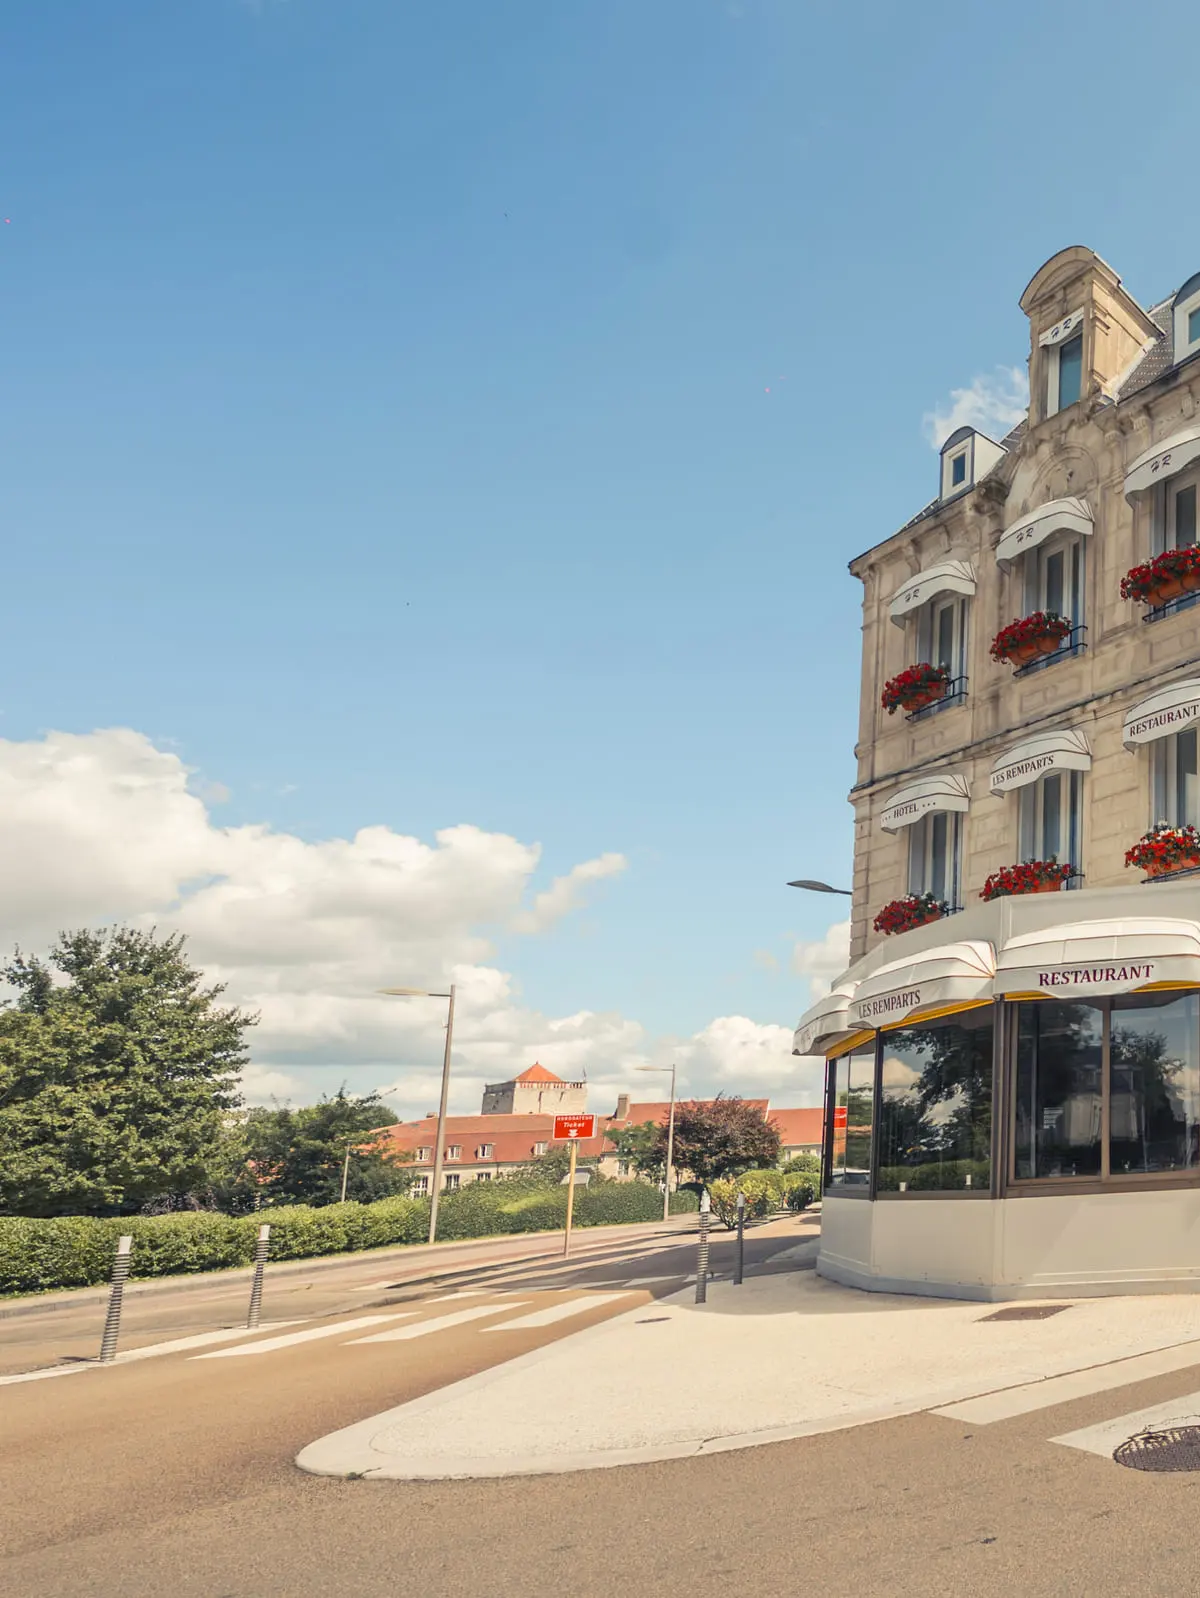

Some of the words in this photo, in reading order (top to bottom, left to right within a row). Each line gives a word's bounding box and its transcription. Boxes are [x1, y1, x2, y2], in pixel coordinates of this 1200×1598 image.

[1129, 704, 1200, 737] RESTAURANT
[992, 772, 1005, 786] LES
[1006, 754, 1055, 780] REMPARTS
[893, 802, 919, 819] HOTEL
[1039, 964, 1155, 987] RESTAURANT
[858, 1003, 872, 1019] LES
[872, 989, 921, 1016] REMPARTS
[563, 1121, 586, 1129] Ticket
